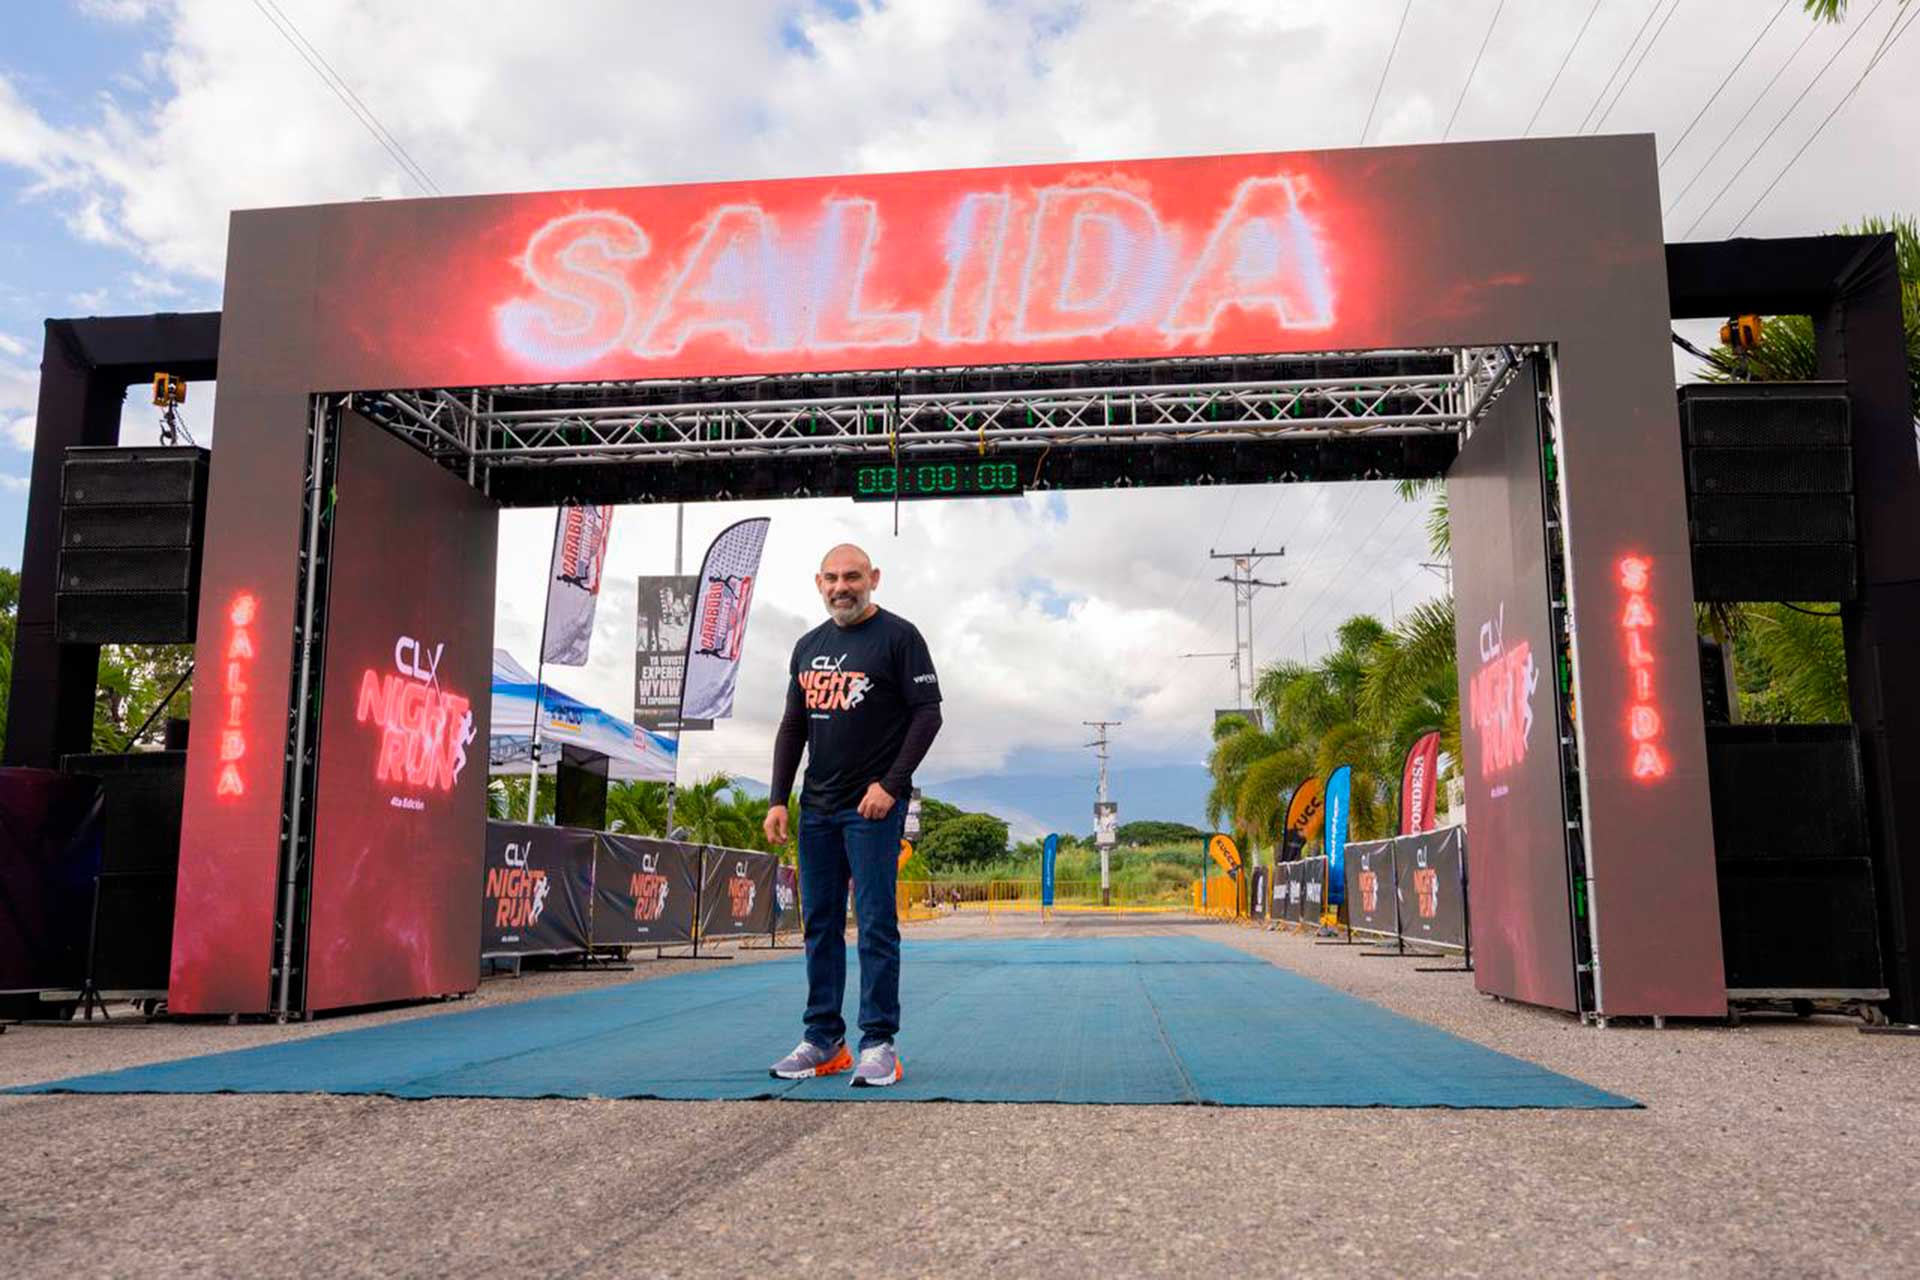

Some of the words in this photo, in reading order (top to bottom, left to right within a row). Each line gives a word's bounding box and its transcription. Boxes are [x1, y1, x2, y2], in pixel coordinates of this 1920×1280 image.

[494, 173, 1335, 368] SALIDA
[858, 464, 1017, 492] 00:00:00
[702, 583, 723, 649] CARABOBO
[395, 635, 444, 694] CLX
[811, 653, 847, 675] CLX
[1620, 556, 1665, 777] SALIDA
[217, 595, 257, 795] SALIDA
[357, 669, 470, 740] NIGHT
[806, 689, 852, 711] RUN
[377, 728, 453, 790] RUN
[486, 867, 545, 898] NIGHT
[629, 872, 668, 897] NIGHT
[496, 897, 535, 927] RUN
[634, 896, 664, 921] RUN
